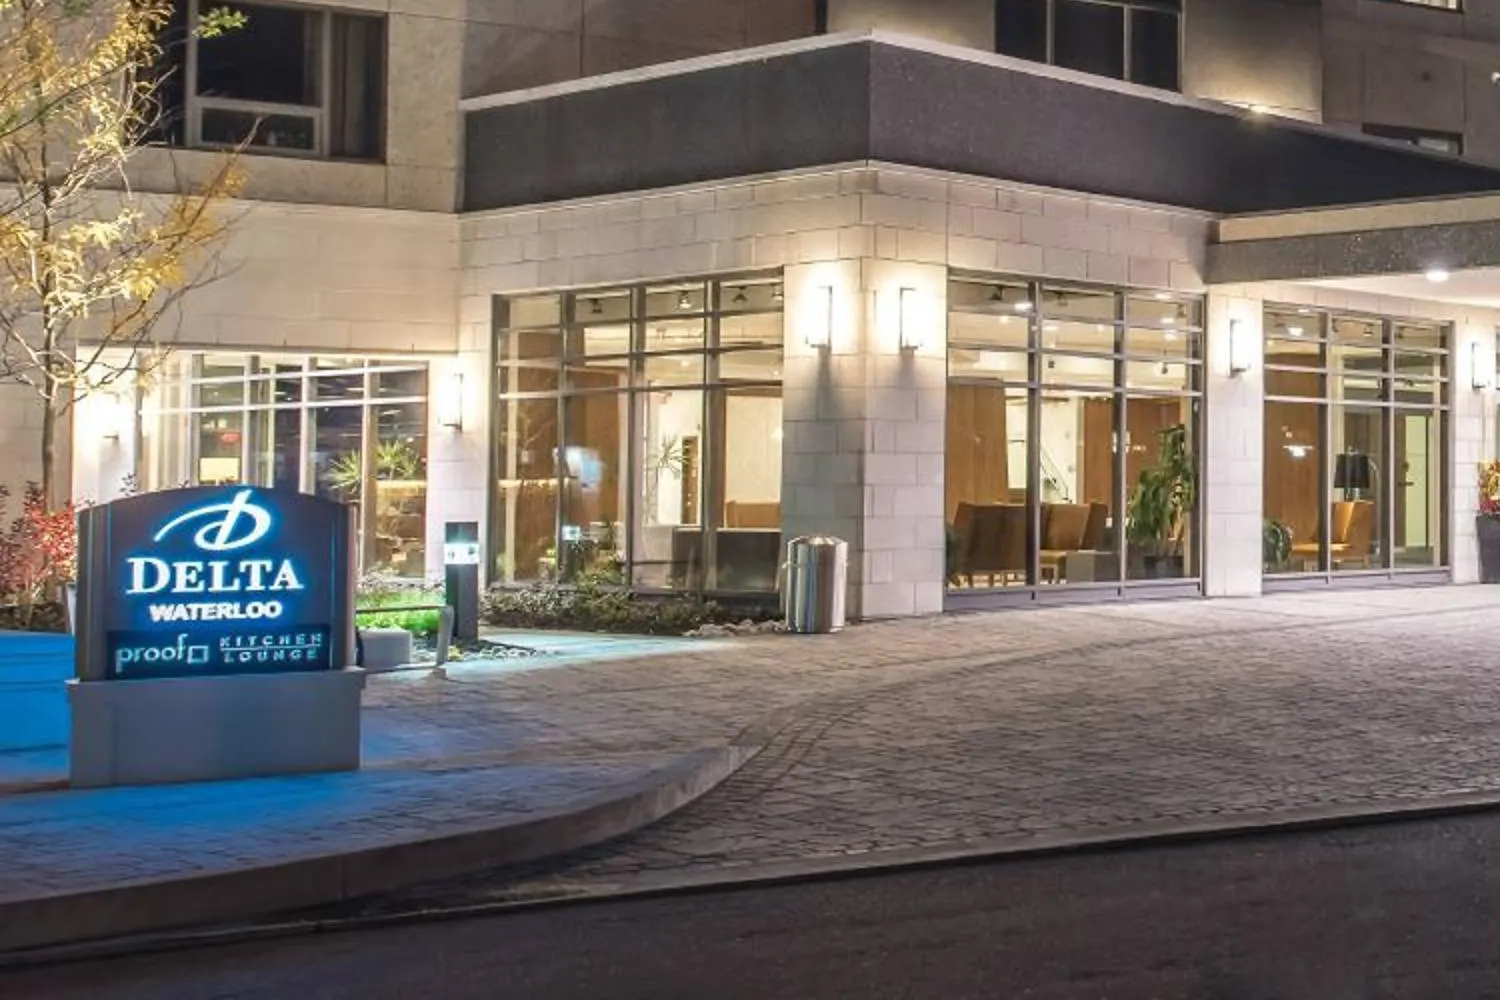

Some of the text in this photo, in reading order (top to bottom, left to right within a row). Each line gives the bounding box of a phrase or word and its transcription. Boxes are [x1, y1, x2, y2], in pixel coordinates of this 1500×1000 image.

[126, 556, 304, 594] DELTA
[149, 600, 283, 622] WATERLOO
[219, 632, 322, 648] KITCHEN
[115, 633, 188, 672] proof
[223, 648, 318, 663] LOUNGE
